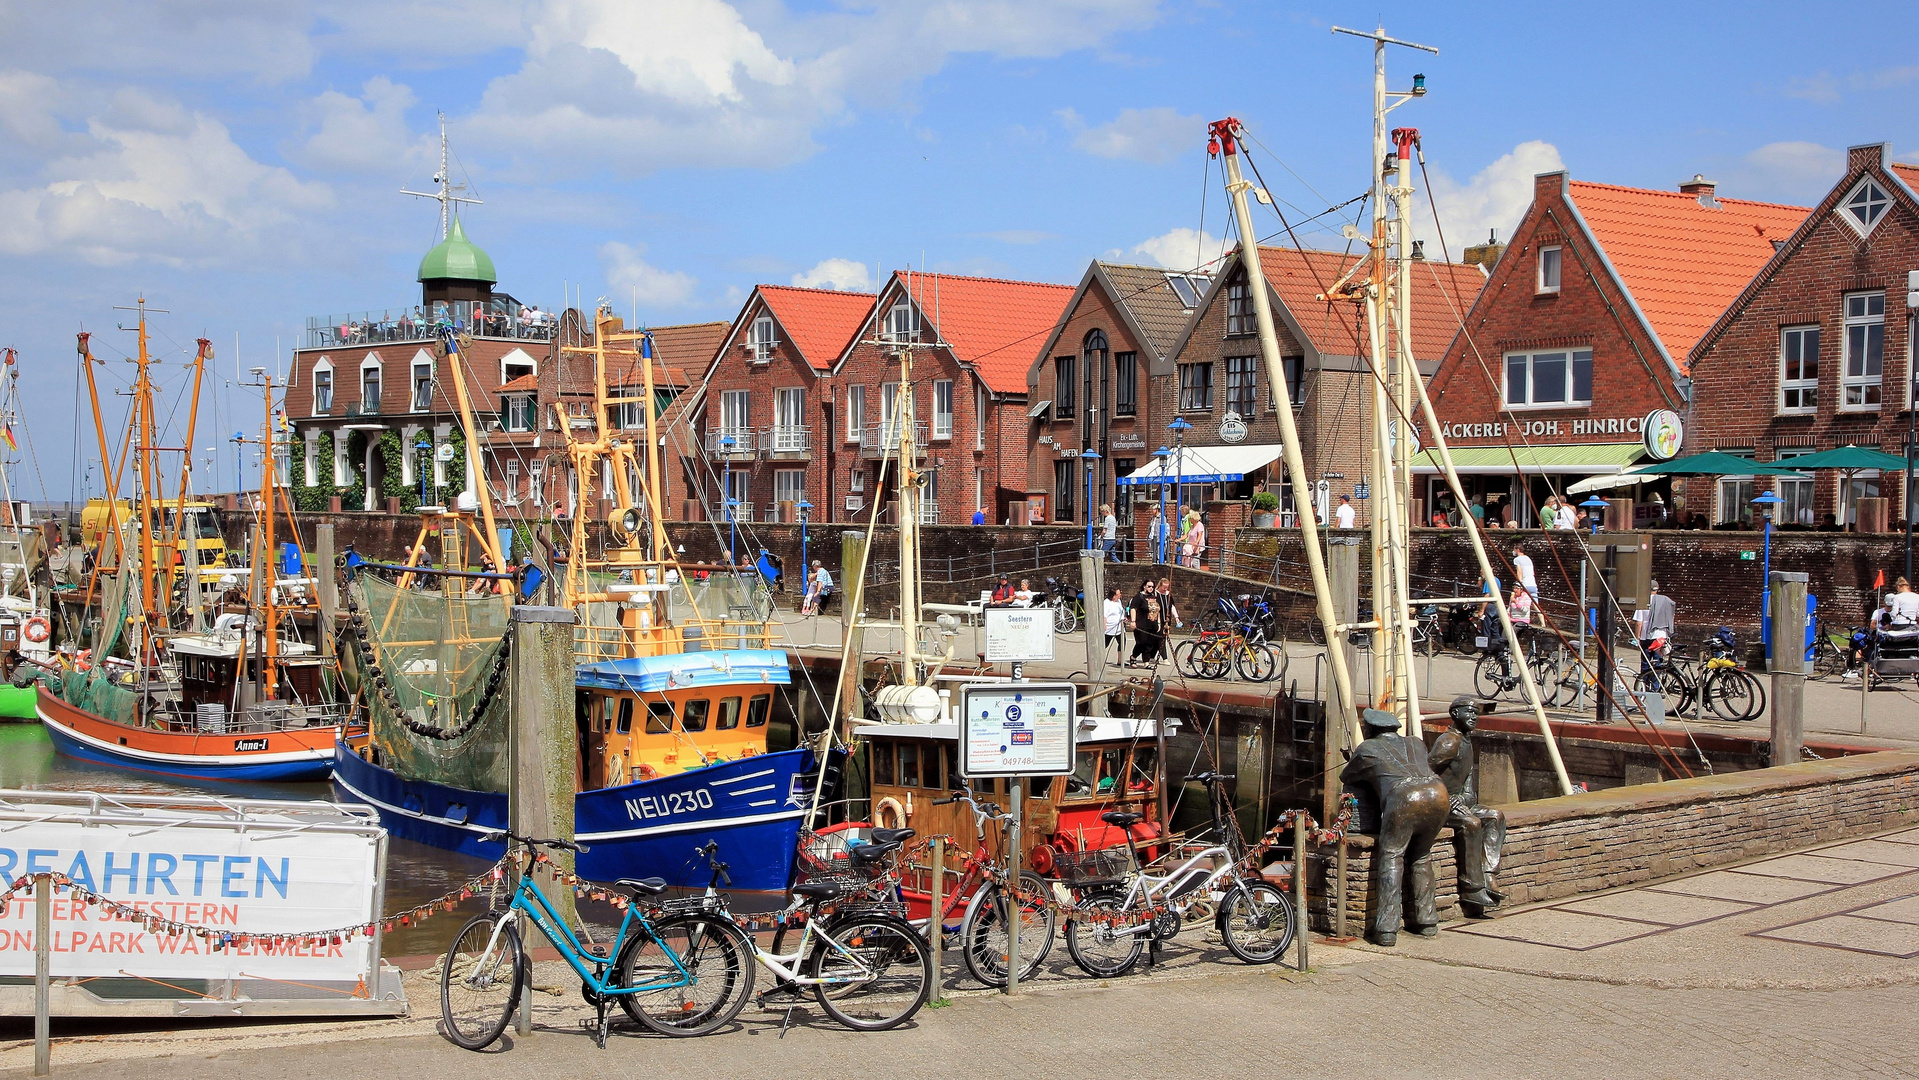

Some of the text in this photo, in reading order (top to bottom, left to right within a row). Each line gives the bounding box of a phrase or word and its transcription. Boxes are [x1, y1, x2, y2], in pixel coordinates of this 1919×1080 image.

[1432, 420, 1508, 438] ÄCKEREI
[1523, 420, 1564, 436] JOH.
[1038, 435, 1053, 444] HAUS
[1053, 442, 1062, 451] AM
[1061, 449, 1079, 457] HAFEN
[1635, 505, 1662, 520] EIS
[1008, 614, 1033, 623] Seestern
[1014, 668, 1022, 679] S
[624, 788, 714, 821] NEU230
